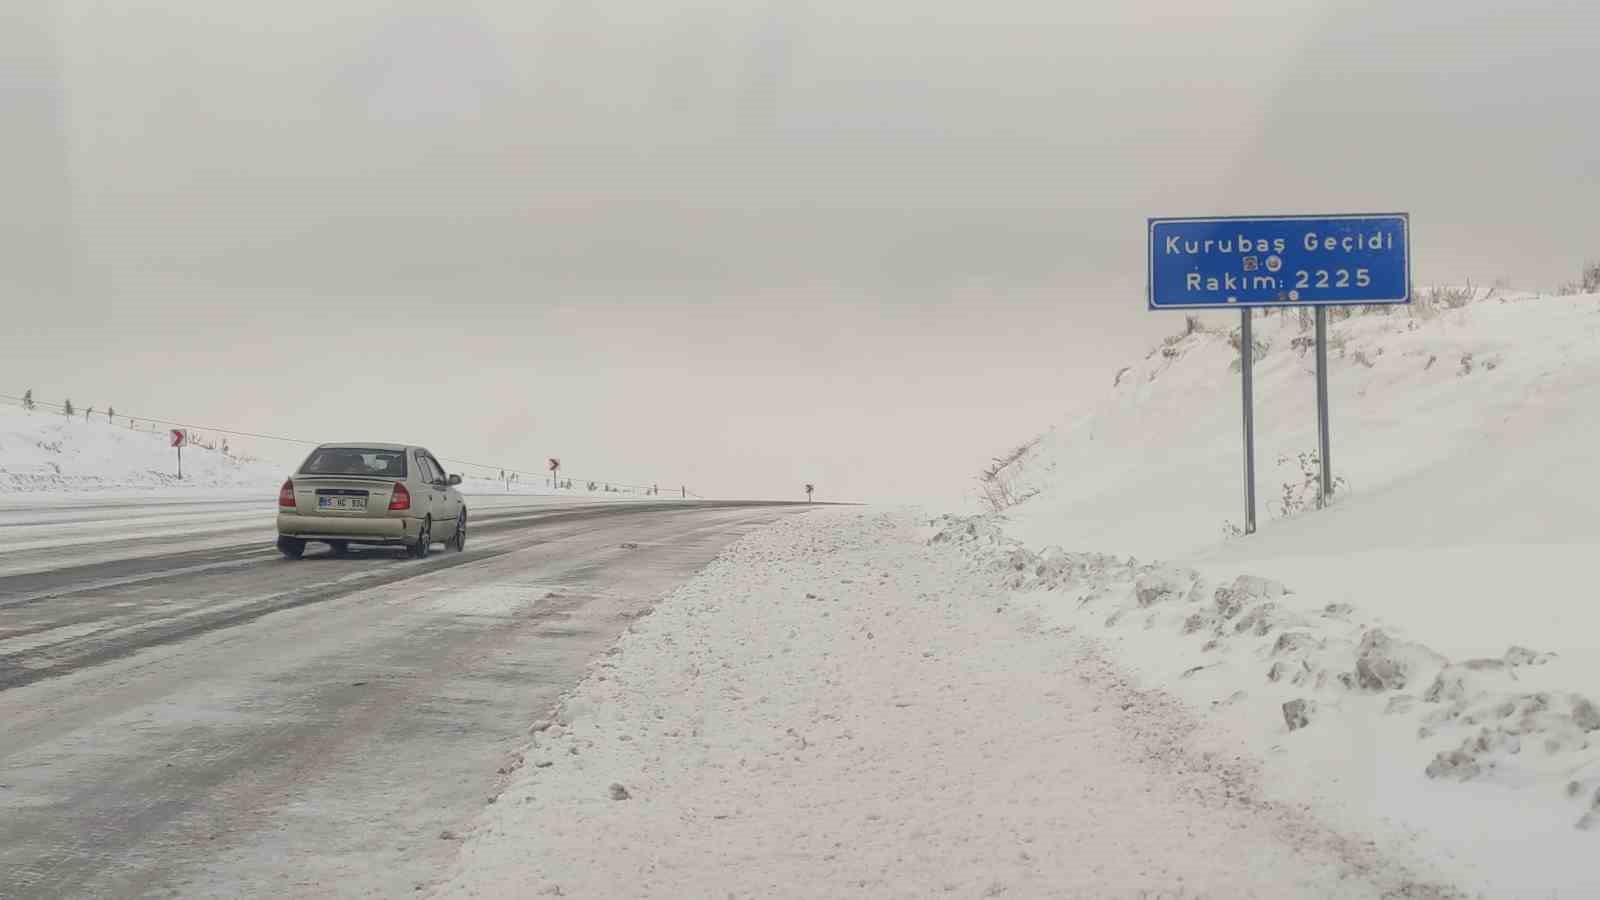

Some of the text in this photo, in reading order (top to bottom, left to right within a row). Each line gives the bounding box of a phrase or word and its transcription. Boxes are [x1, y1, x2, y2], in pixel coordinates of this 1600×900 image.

[1165, 231, 1393, 254] Kurubaş Geçidi
[1186, 268, 1371, 291] Rakım: 2225
